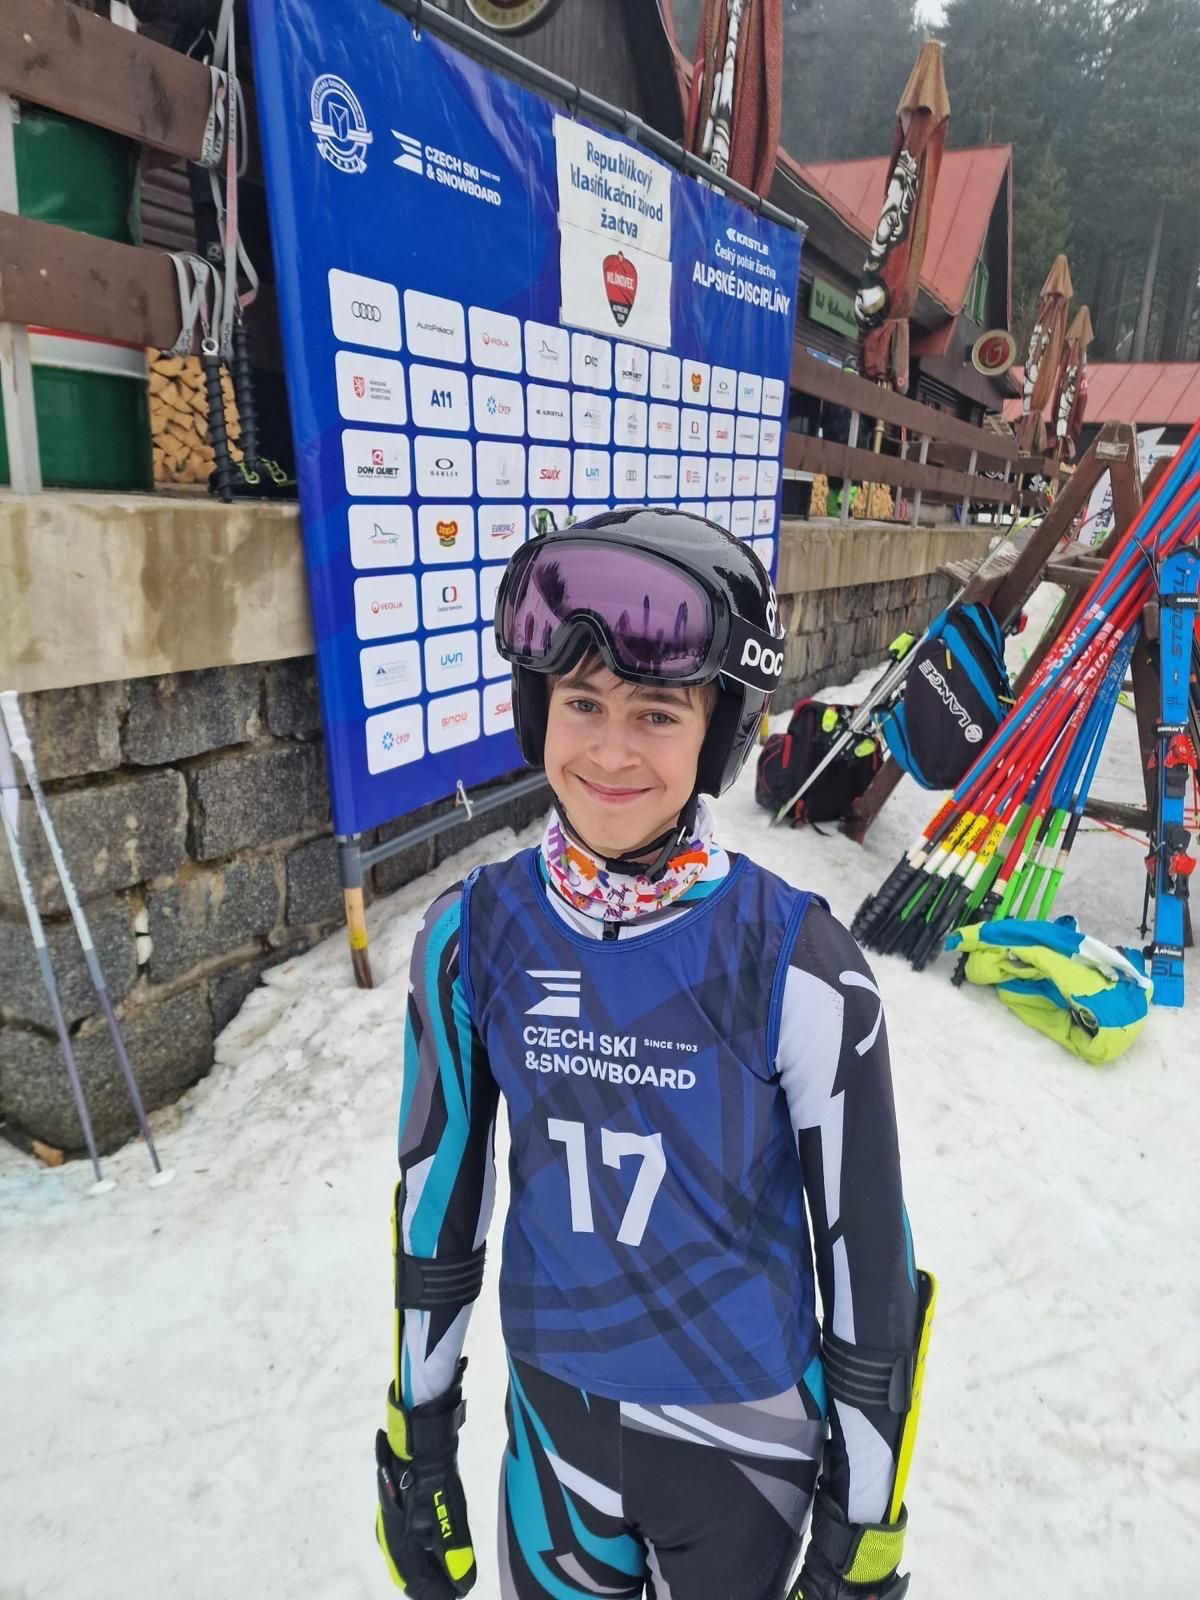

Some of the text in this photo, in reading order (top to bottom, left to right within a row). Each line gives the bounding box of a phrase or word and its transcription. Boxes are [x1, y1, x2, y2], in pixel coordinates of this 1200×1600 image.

[425, 145, 461, 173] CZECH
[463, 163, 479, 181] SKI
[426, 164, 501, 206] & SNOWBOARD
[600, 208, 638, 239] žactva
[714, 238, 736, 266] Český
[755, 259, 776, 280] žactva
[693, 261, 736, 297] ALPSKÉ
[736, 278, 790, 315] DISCIPLÍNY
[430, 389, 452, 409] A11
[357, 466, 399, 475] DON QUIET
[381, 602, 403, 610] VEOLIA
[918, 658, 972, 728] LANGE
[523, 1025, 698, 1057] CZECH SKI SINCE 1903
[547, 1117, 667, 1247] 17
[433, 1490, 452, 1538] LEKI
